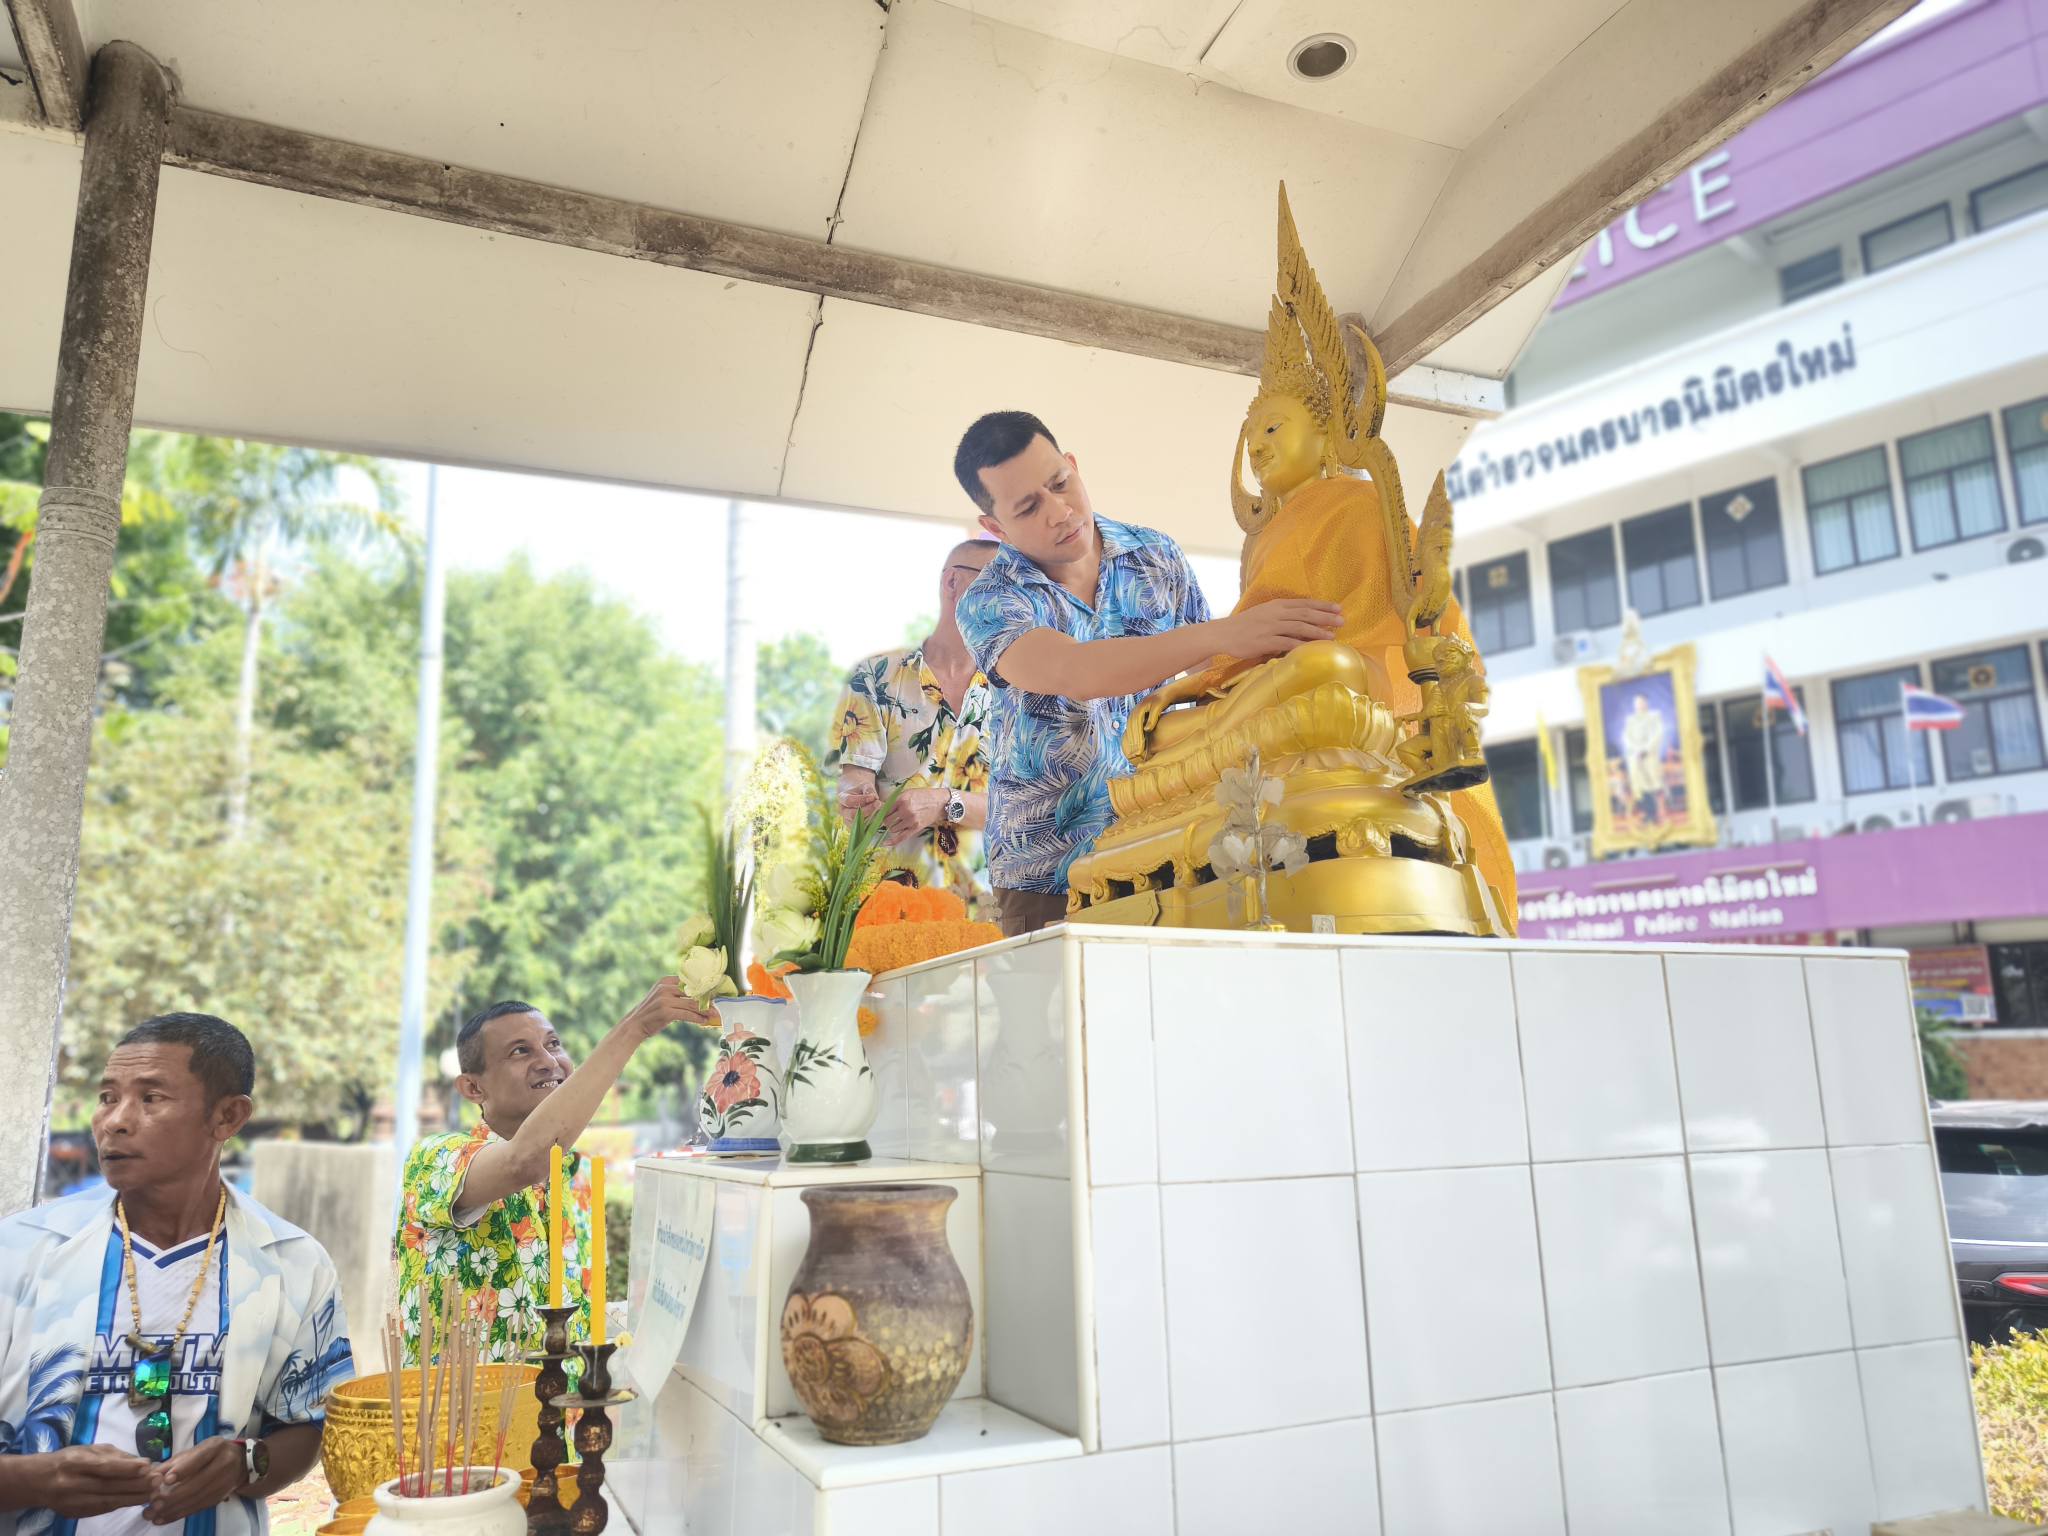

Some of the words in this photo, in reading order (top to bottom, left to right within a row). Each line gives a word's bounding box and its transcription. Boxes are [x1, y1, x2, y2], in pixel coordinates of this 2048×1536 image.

[1571, 150, 1738, 280] ICE
[1633, 911, 1699, 937] Police
[1708, 903, 1784, 929] Station
